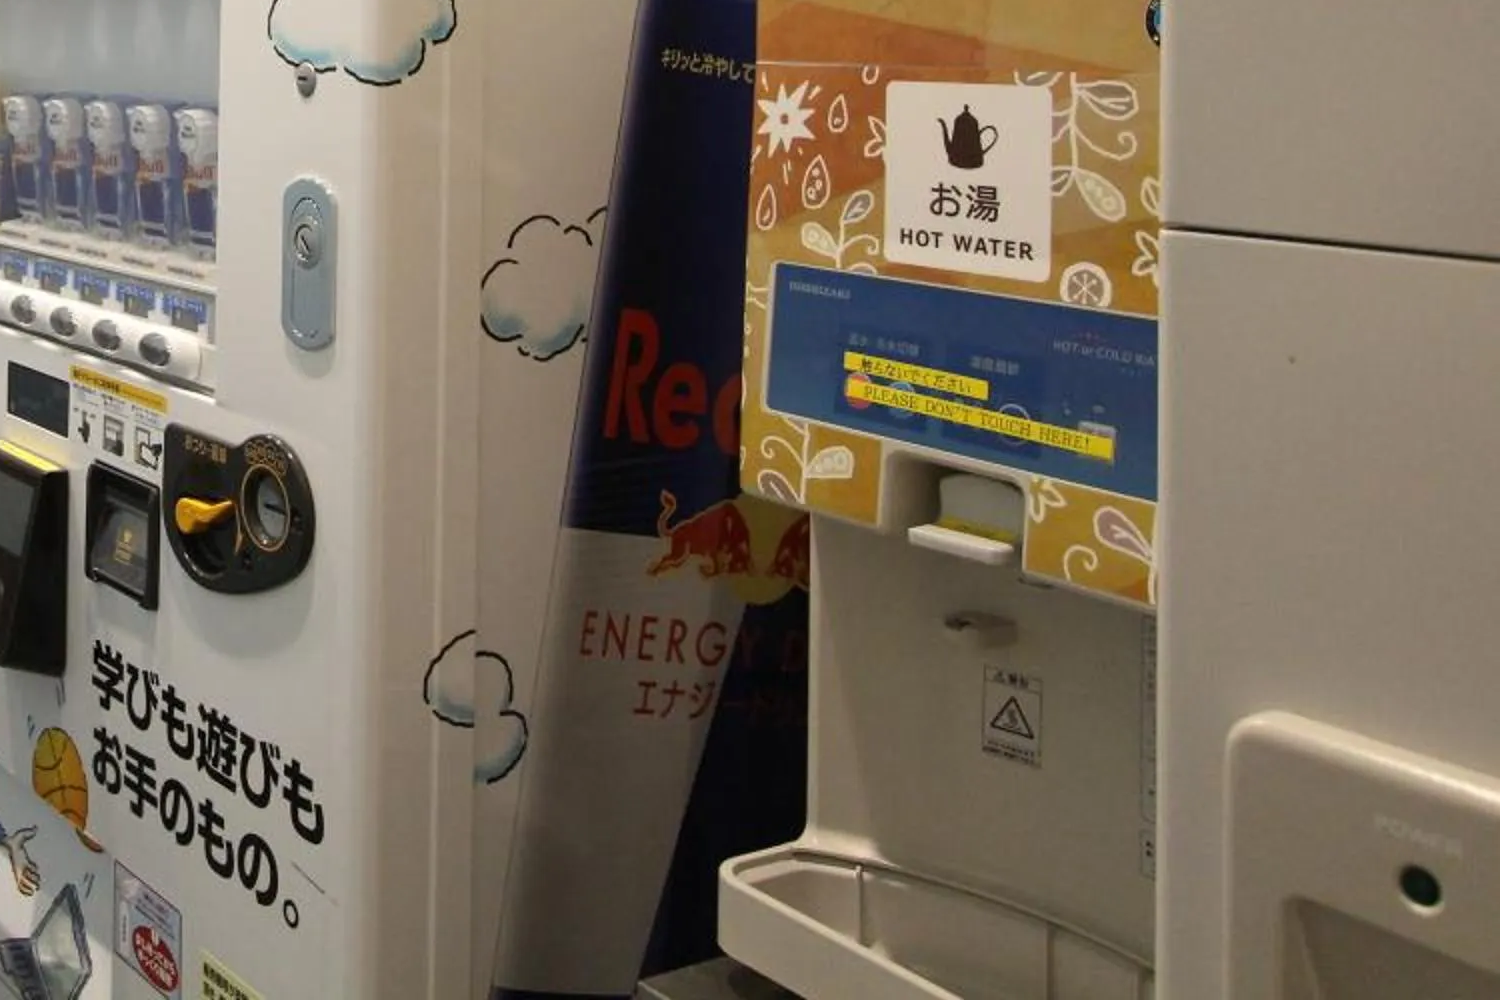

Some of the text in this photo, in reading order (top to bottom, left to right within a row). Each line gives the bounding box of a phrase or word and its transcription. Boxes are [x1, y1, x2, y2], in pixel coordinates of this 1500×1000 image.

[929, 183, 1001, 225] お湯
[899, 228, 1035, 262] HOT WATER
[860, 358, 974, 395] 触らないでください
[863, 385, 1092, 453] PLEASE DON'T TOUCH HERE!
[579, 609, 762, 671] ENERGY
[92, 639, 325, 845] 学びも遊びも
[92, 727, 300, 930] お手のもの。
